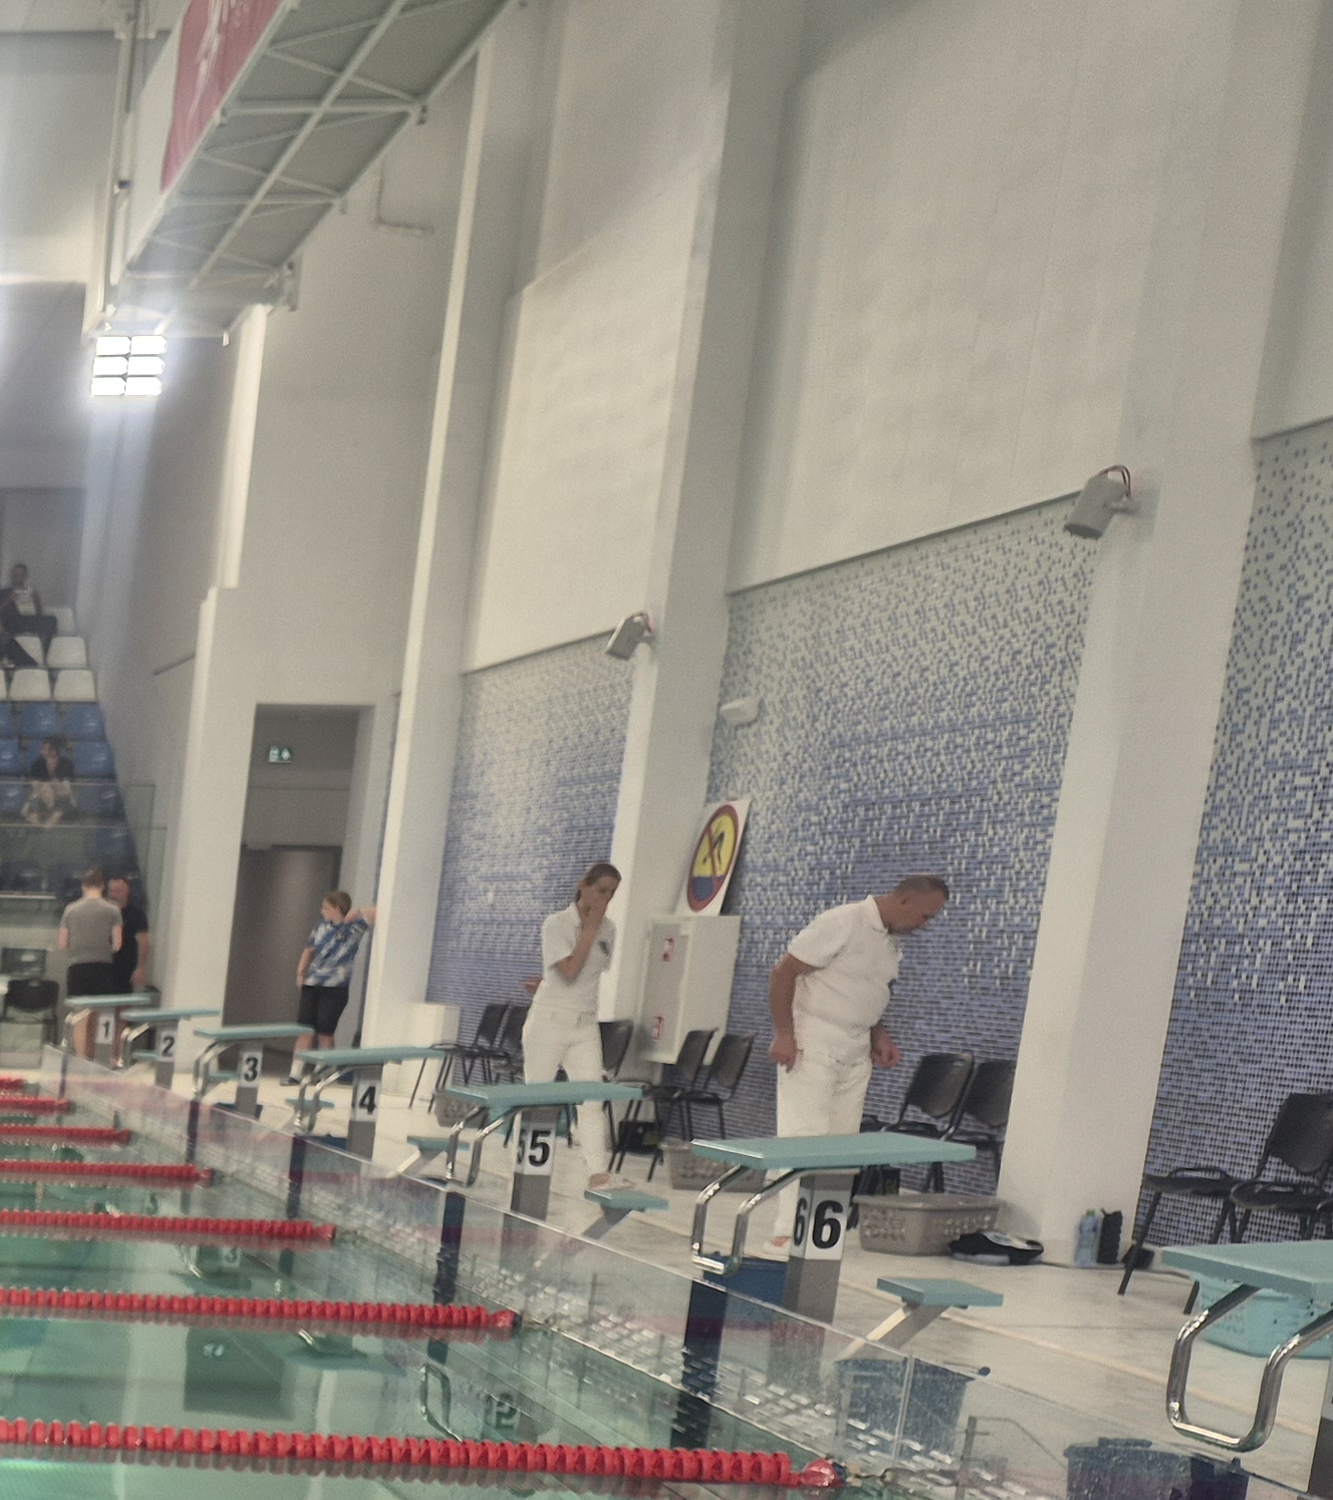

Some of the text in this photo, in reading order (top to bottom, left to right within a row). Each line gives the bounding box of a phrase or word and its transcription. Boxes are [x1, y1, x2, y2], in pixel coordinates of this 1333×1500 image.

[101, 1019, 111, 1039] 1
[162, 1035, 175, 1058] 2
[243, 1056, 259, 1083] 3
[359, 1086, 377, 1116] 4
[528, 1130, 552, 1167] 5
[812, 1200, 844, 1250] 6
